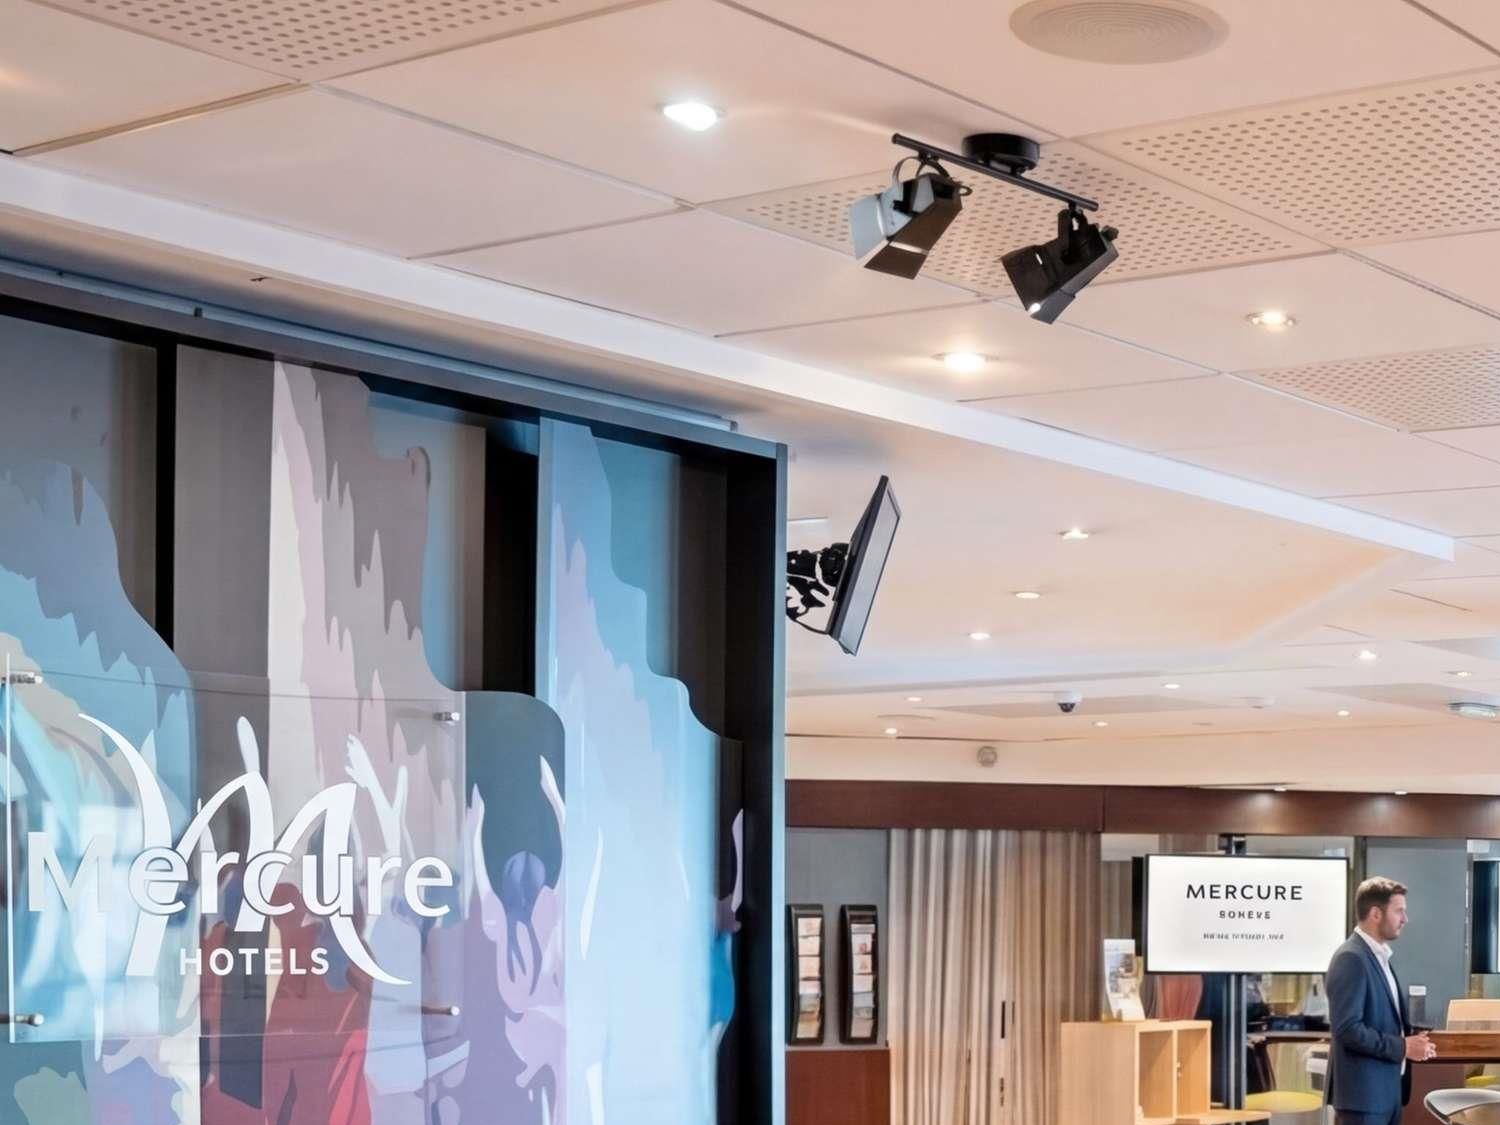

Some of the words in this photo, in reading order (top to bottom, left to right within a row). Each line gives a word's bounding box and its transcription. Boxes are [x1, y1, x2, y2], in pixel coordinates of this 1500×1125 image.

[27, 831, 454, 917] Mercure
[1186, 884, 1303, 900] MERCURE
[180, 947, 330, 977] HOTELS
